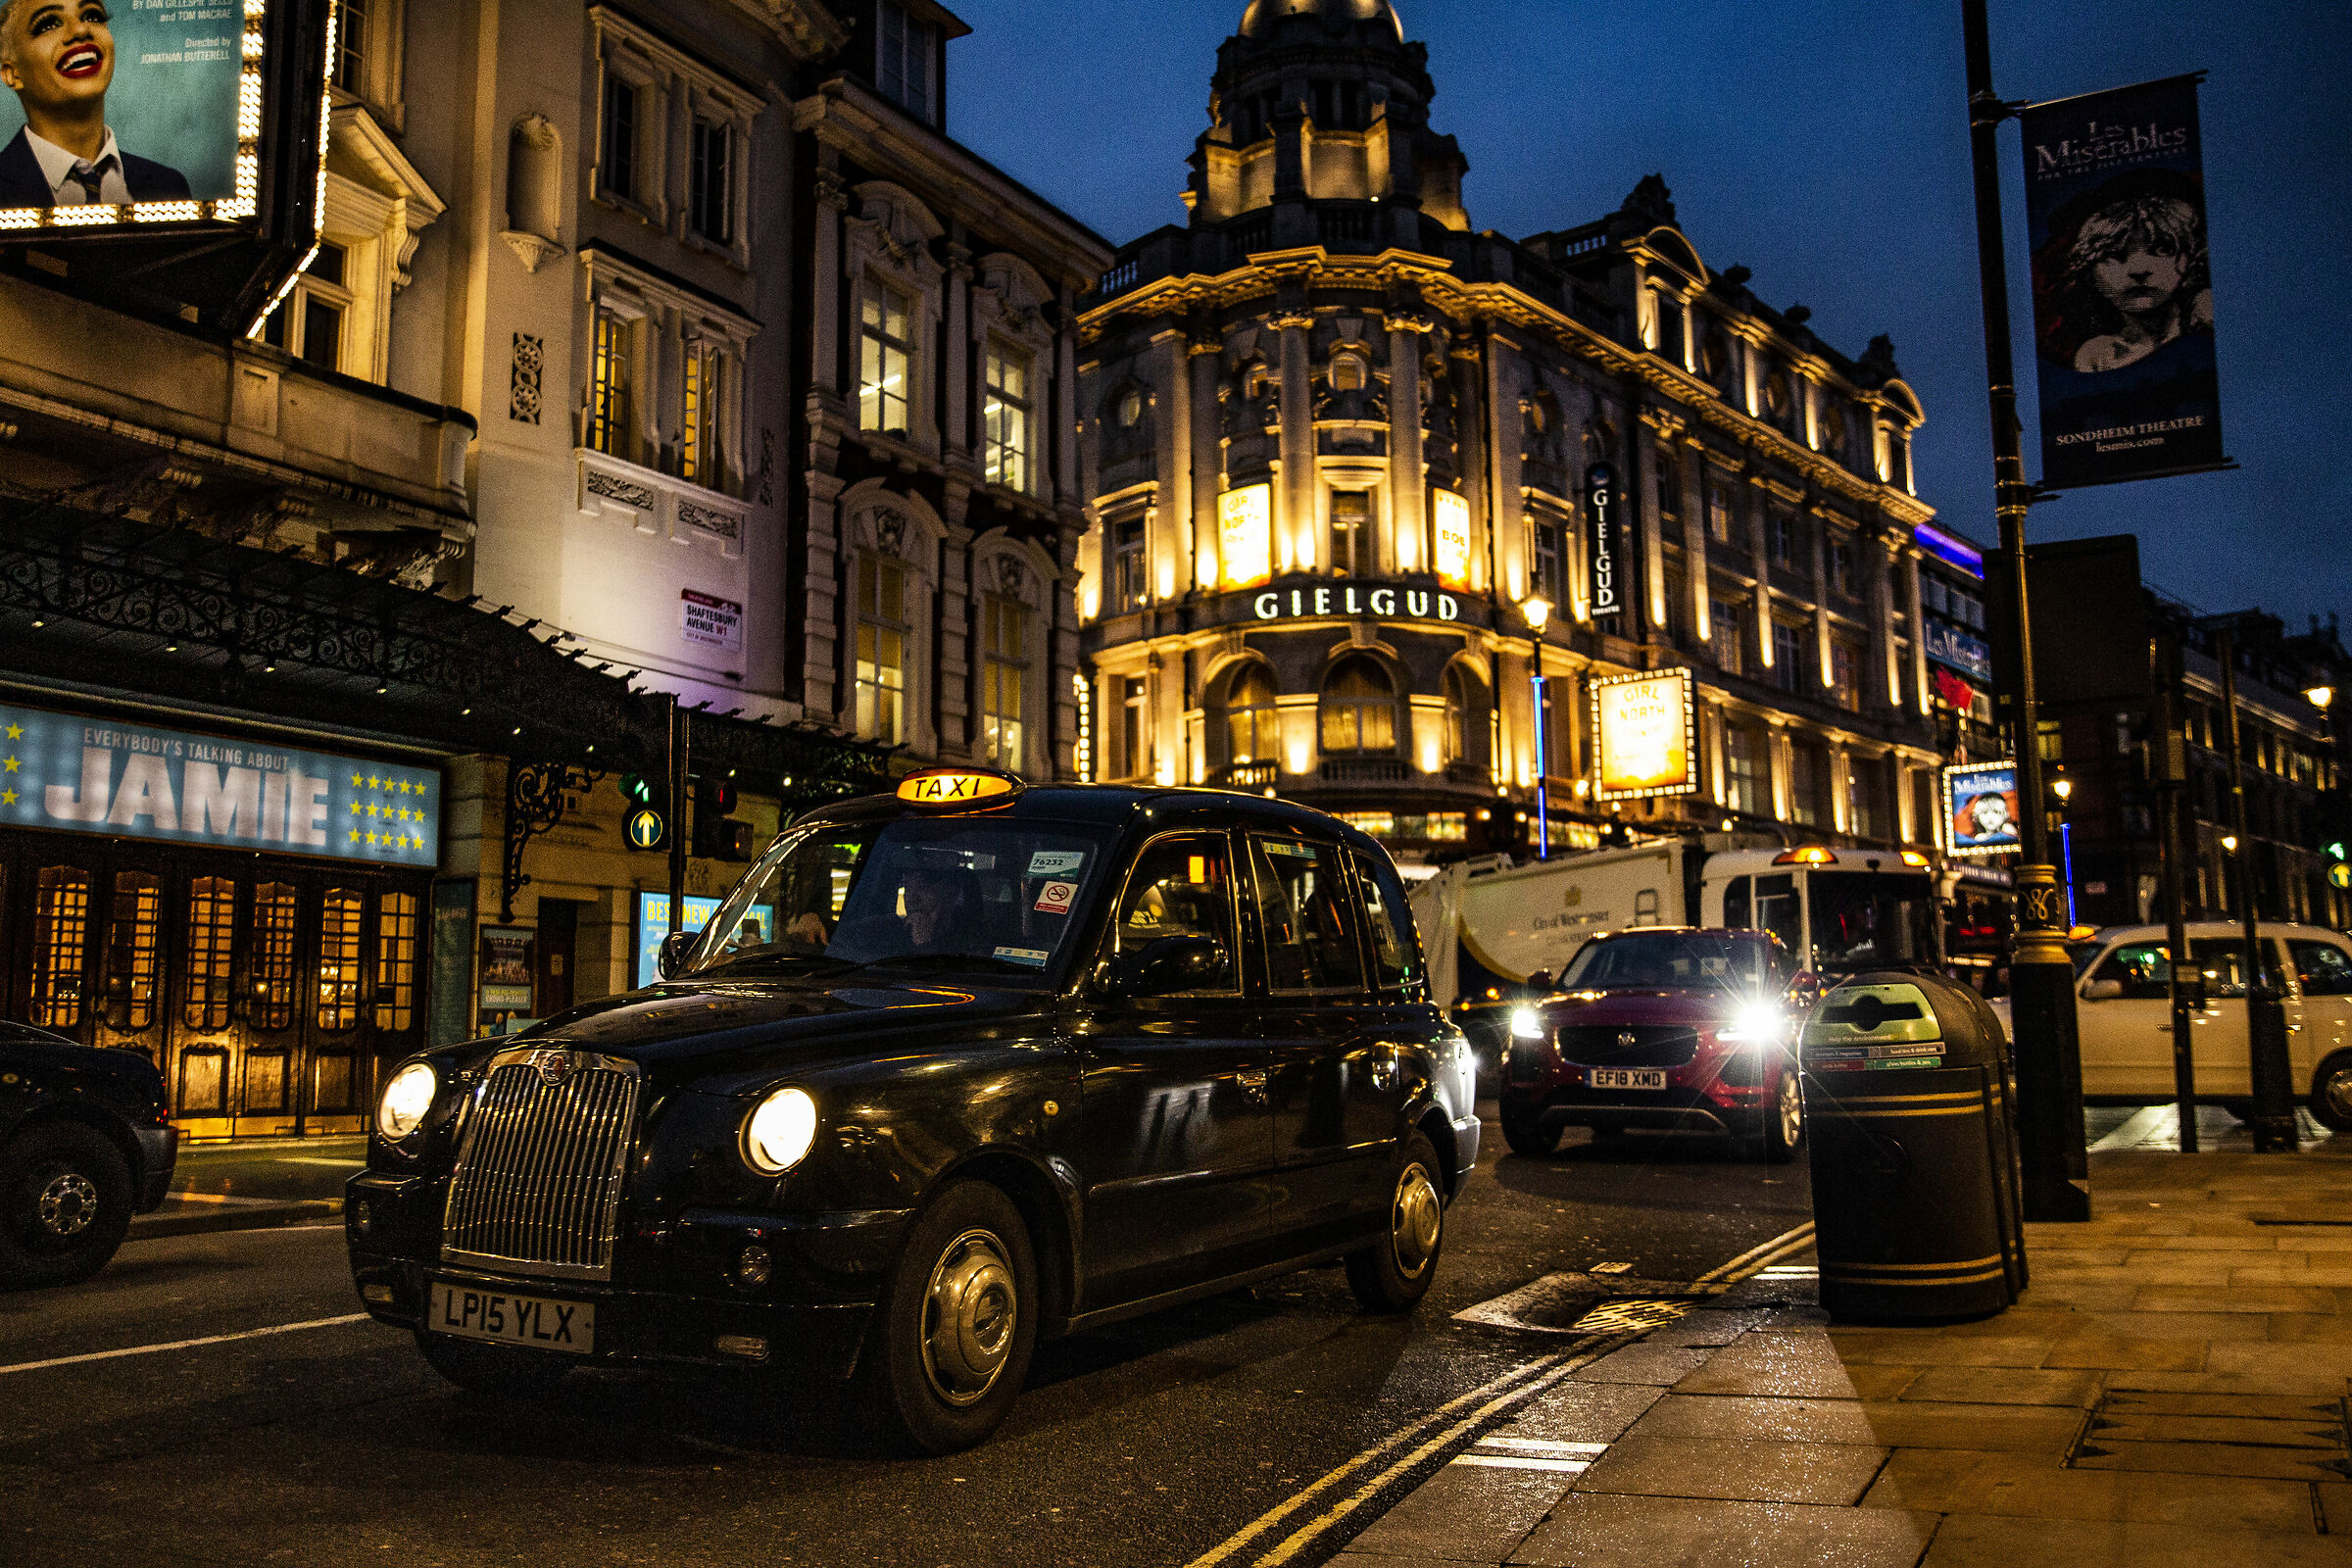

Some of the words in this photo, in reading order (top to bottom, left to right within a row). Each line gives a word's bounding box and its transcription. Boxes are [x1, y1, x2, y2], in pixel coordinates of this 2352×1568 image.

[160, 13, 176, 23] and
[178, 11, 196, 21] TOM
[198, 9, 232, 20] MACRAE
[185, 37, 220, 48] Directed
[221, 37, 231, 48] by
[140, 52, 183, 65] JONATHAN
[183, 50, 229, 62] BUTTERELL
[2088, 121, 2125, 142] Les
[2055, 424, 2136, 446] SONDHEIM
[2137, 416, 2205, 435] THEATRE
[1593, 489, 1614, 607] GIELGUD
[1254, 587, 1458, 620] GIELGUD
[686, 616, 714, 633] AVENUE
[716, 625, 727, 636] W1
[687, 604, 738, 627] SHAFTESBURY
[1624, 685, 1660, 702] GIRL
[1620, 705, 1665, 720] NORTH
[83, 727, 183, 757] EVERYBODY'S
[188, 742, 243, 764] TALKING
[247, 752, 290, 770] ABOUT
[44, 747, 330, 846] JAMIE
[915, 777, 981, 798] TAXI
[647, 901, 670, 922] BES
[683, 904, 710, 924] NEW
[1595, 1070, 1628, 1085] EF18
[1632, 1071, 1661, 1086] XMD
[445, 1290, 506, 1333] LP15
[515, 1299, 574, 1344] YLX
